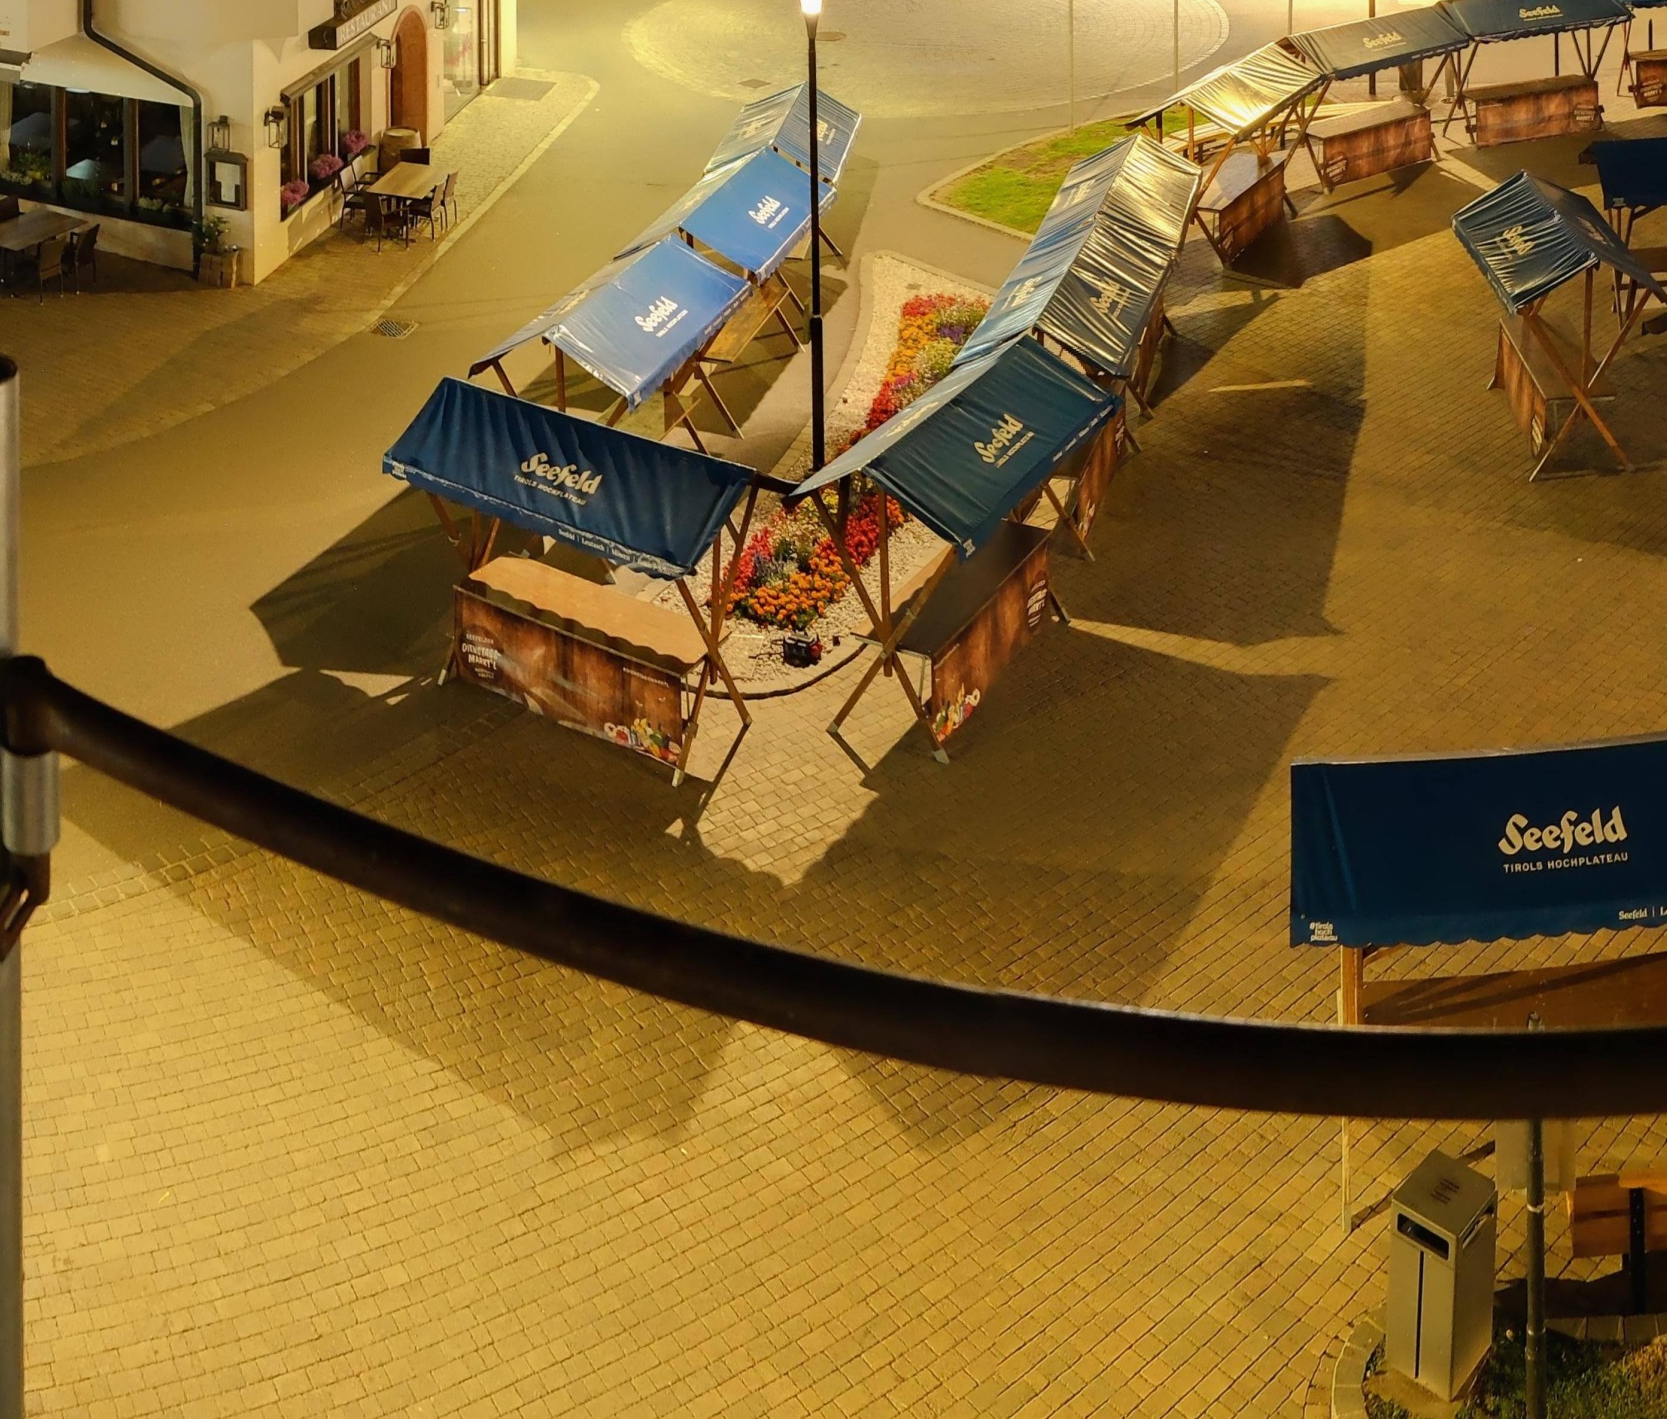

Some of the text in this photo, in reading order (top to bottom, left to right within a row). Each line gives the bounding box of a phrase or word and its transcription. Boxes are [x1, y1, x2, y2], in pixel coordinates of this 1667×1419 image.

[1518, 4, 1561, 18] Seefeld
[973, 413, 1025, 464] Seefeld
[520, 451, 603, 495] Seefeld
[1498, 804, 1628, 856] Seefeld
[1502, 851, 1629, 874] TIROLS HOCHPLATEAU
[1618, 907, 1648, 921] Seefeld
